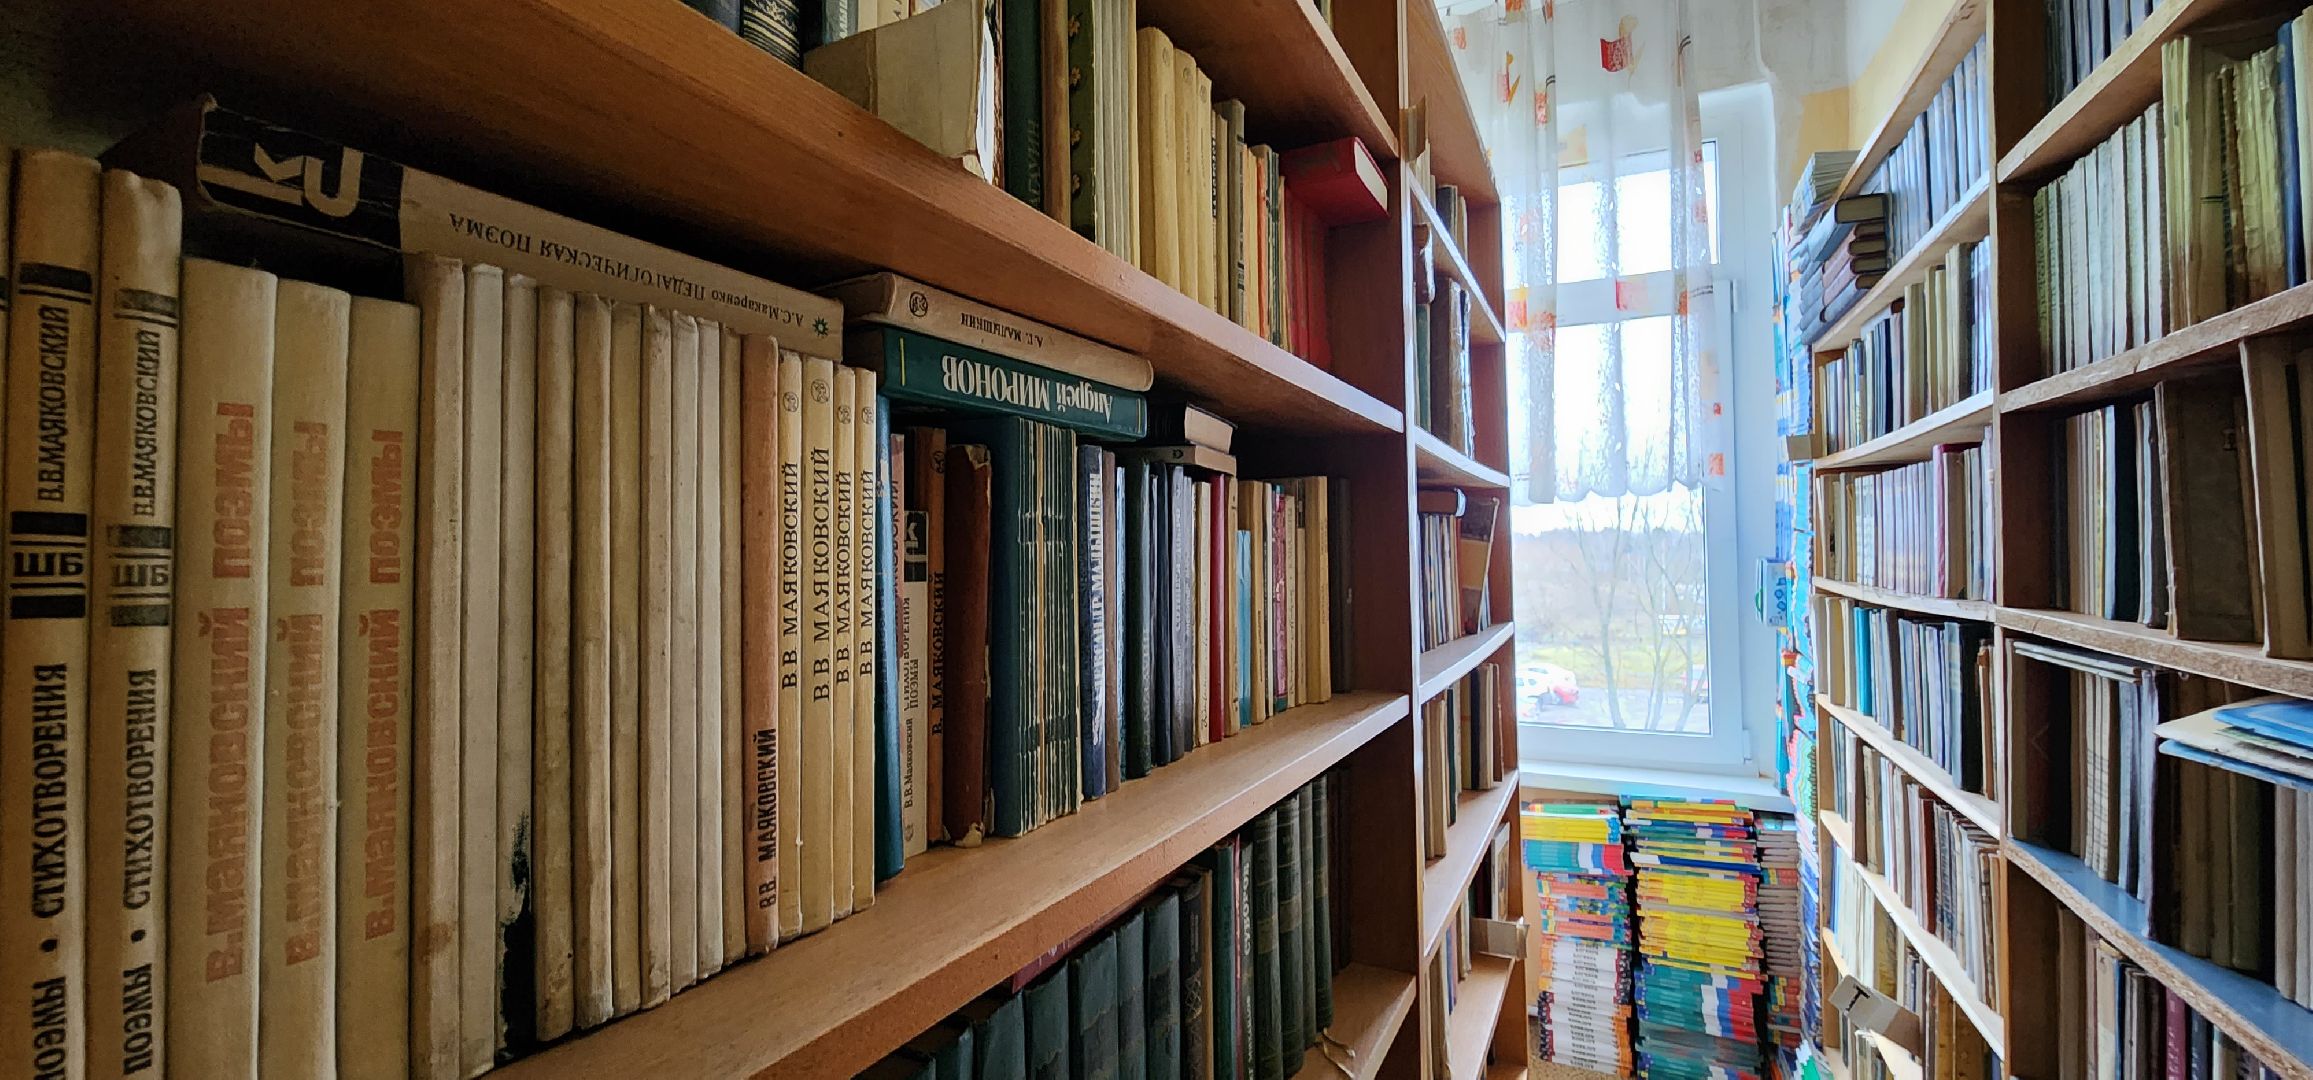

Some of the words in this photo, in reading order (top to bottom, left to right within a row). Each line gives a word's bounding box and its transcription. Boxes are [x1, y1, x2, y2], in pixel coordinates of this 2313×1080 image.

[448, 212, 531, 255] ПОЭМА
[539, 238, 706, 302] ПЕДАГОГИЧЕСКАЯ
[960, 311, 1022, 343] МАЛЫШКИН
[941, 354, 1051, 412] МИРОНОВ
[1056, 381, 1114, 424] Андрей
[13, 552, 84, 578] ШБ
[111, 564, 170, 588] ШБ
[778, 461, 799, 636] МАЯКОВСКИЙ
[810, 446, 831, 643] МАЯКОВСКИЙ
[834, 470, 852, 636] МАЯКОВСКИЙ
[857, 469, 874, 628] МАЯКОВСКИЙ
[910, 658, 919, 709] ПОЭМЫ
[929, 572, 945, 710] МАЯКОВСКИЙ
[32, 663, 68, 919] СТИХОТВОРЕНИЯ
[122, 668, 157, 911] СТИХОТВОРЕНИЯ
[753, 728, 777, 862] МАЯКОВСКИЙ
[1242, 862, 1251, 956] СУВОРОВ
[122, 963, 153, 1076] ПОЭМЫ
